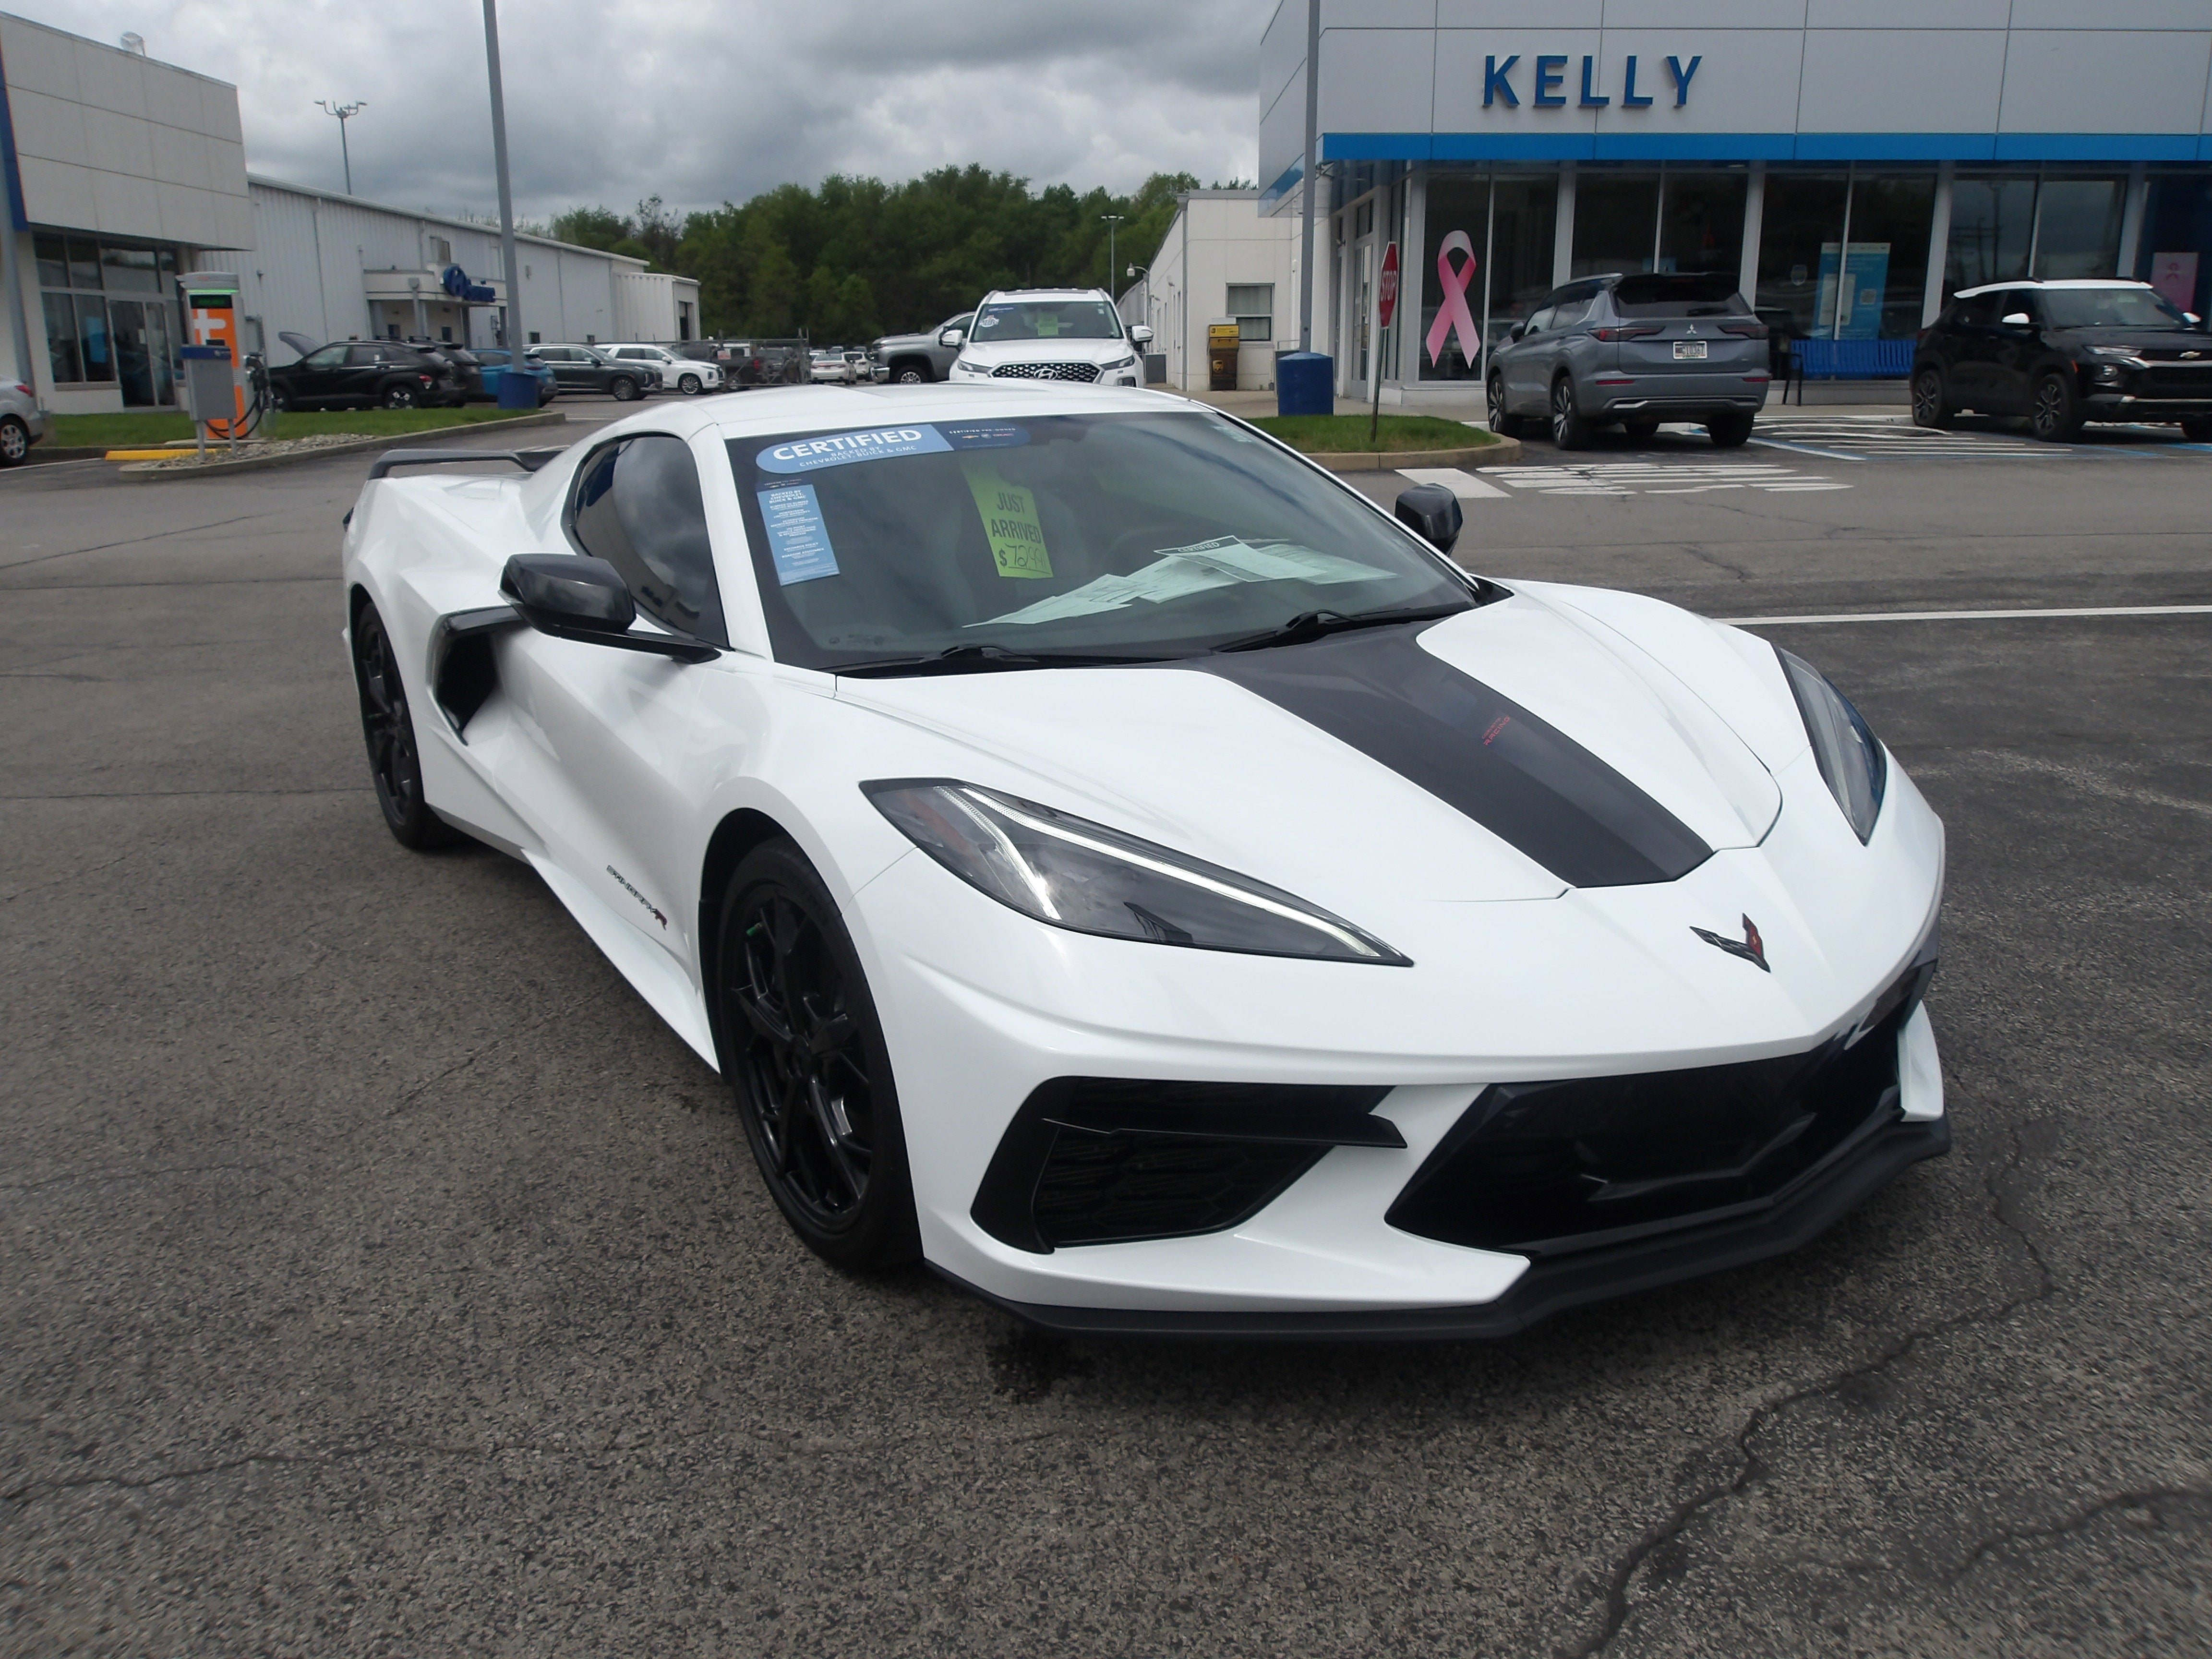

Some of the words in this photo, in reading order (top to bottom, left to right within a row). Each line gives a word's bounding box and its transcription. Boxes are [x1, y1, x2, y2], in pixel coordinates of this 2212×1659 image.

[1483, 55, 1703, 106] KELLY
[1381, 270, 1397, 301] STOP
[773, 430, 922, 460] CERTIFIED
[831, 447, 866, 457] BACKED
[997, 492, 1025, 514] JUST
[991, 518, 1041, 544] ARRIVED
[1178, 541, 1220, 553] CERTIFIED
[1483, 715, 1510, 745] RACING
